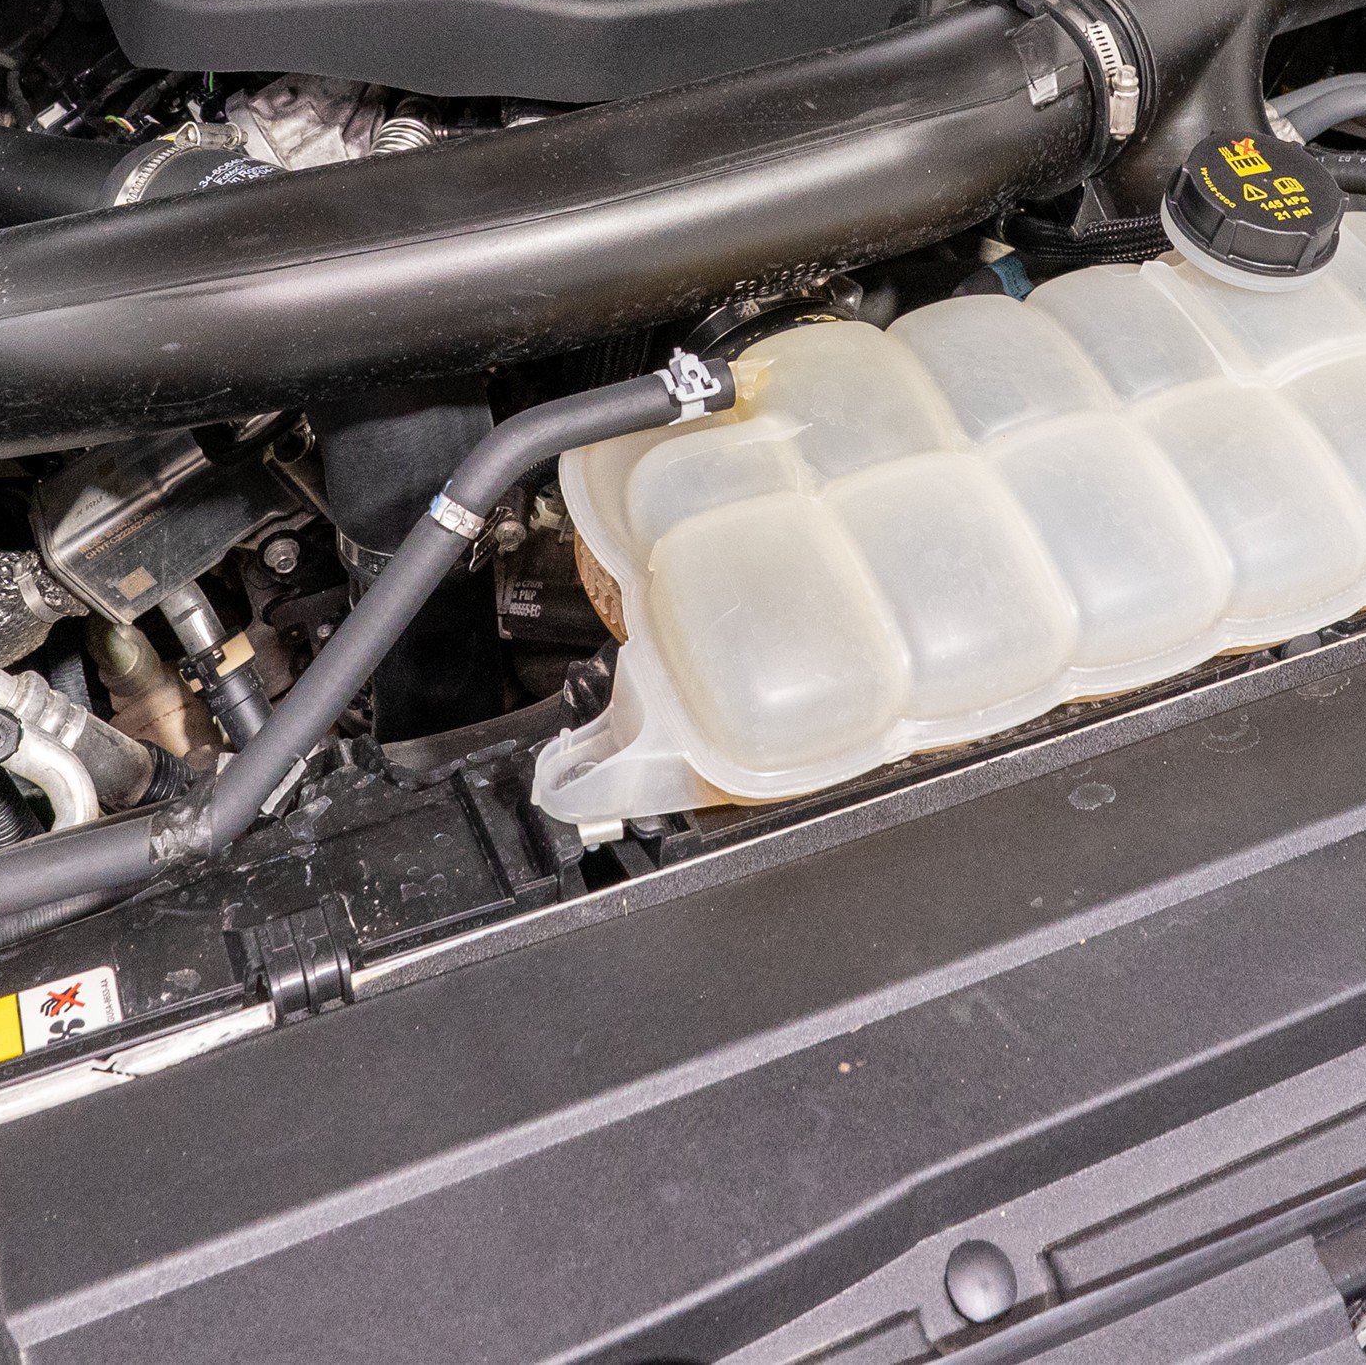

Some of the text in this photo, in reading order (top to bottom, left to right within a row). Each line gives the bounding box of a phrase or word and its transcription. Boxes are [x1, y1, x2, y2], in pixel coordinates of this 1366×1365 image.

[1259, 195, 1310, 212] 145 kPa
[1274, 206, 1314, 221] 21 psi
